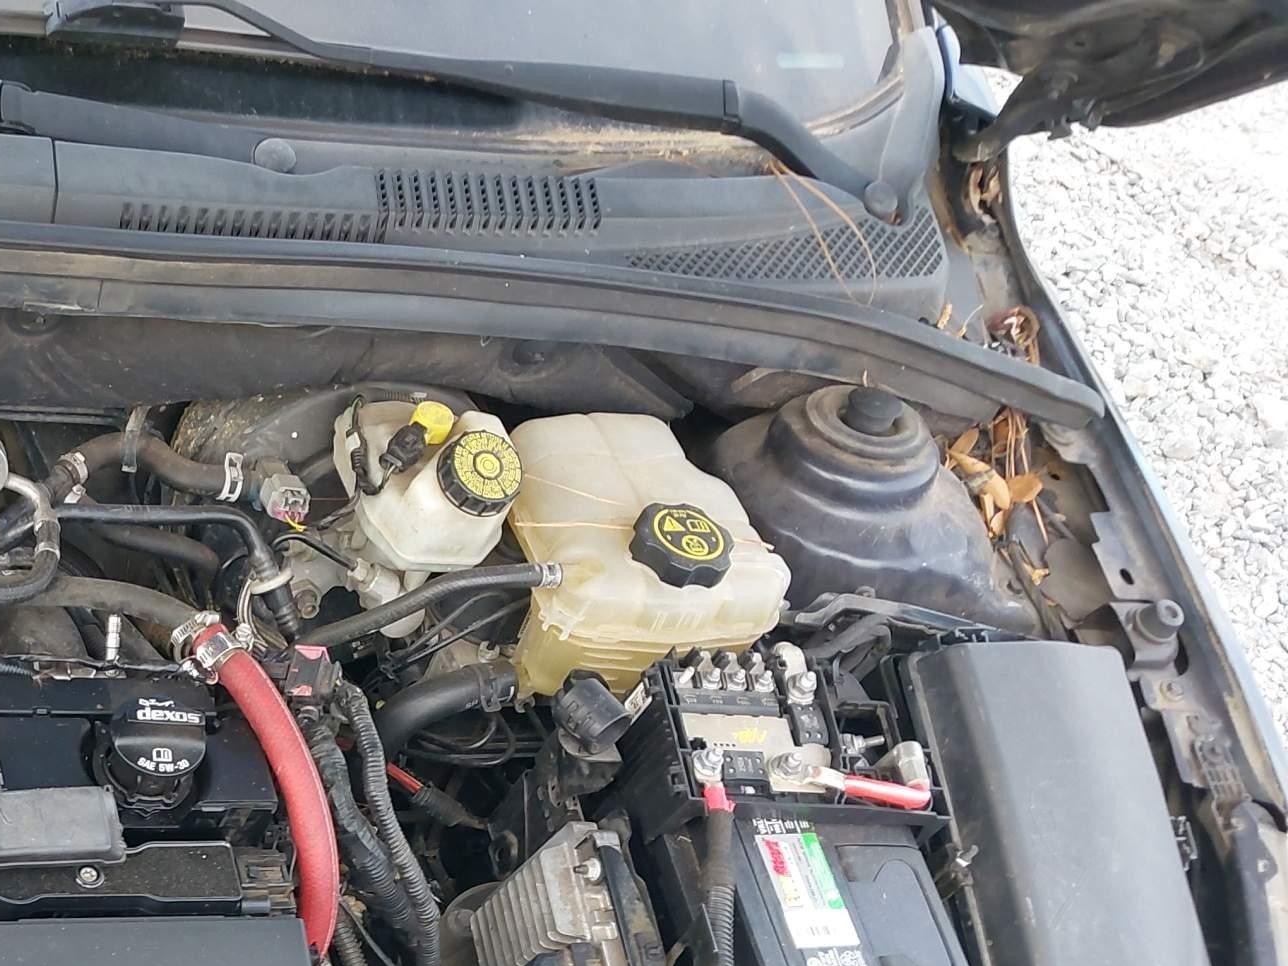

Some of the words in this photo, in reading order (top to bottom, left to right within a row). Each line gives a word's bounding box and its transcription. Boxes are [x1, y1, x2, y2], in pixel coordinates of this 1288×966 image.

[136, 707, 203, 723] dexos
[137, 757, 156, 771] SAE
[158, 758, 190, 773] 5W-30
